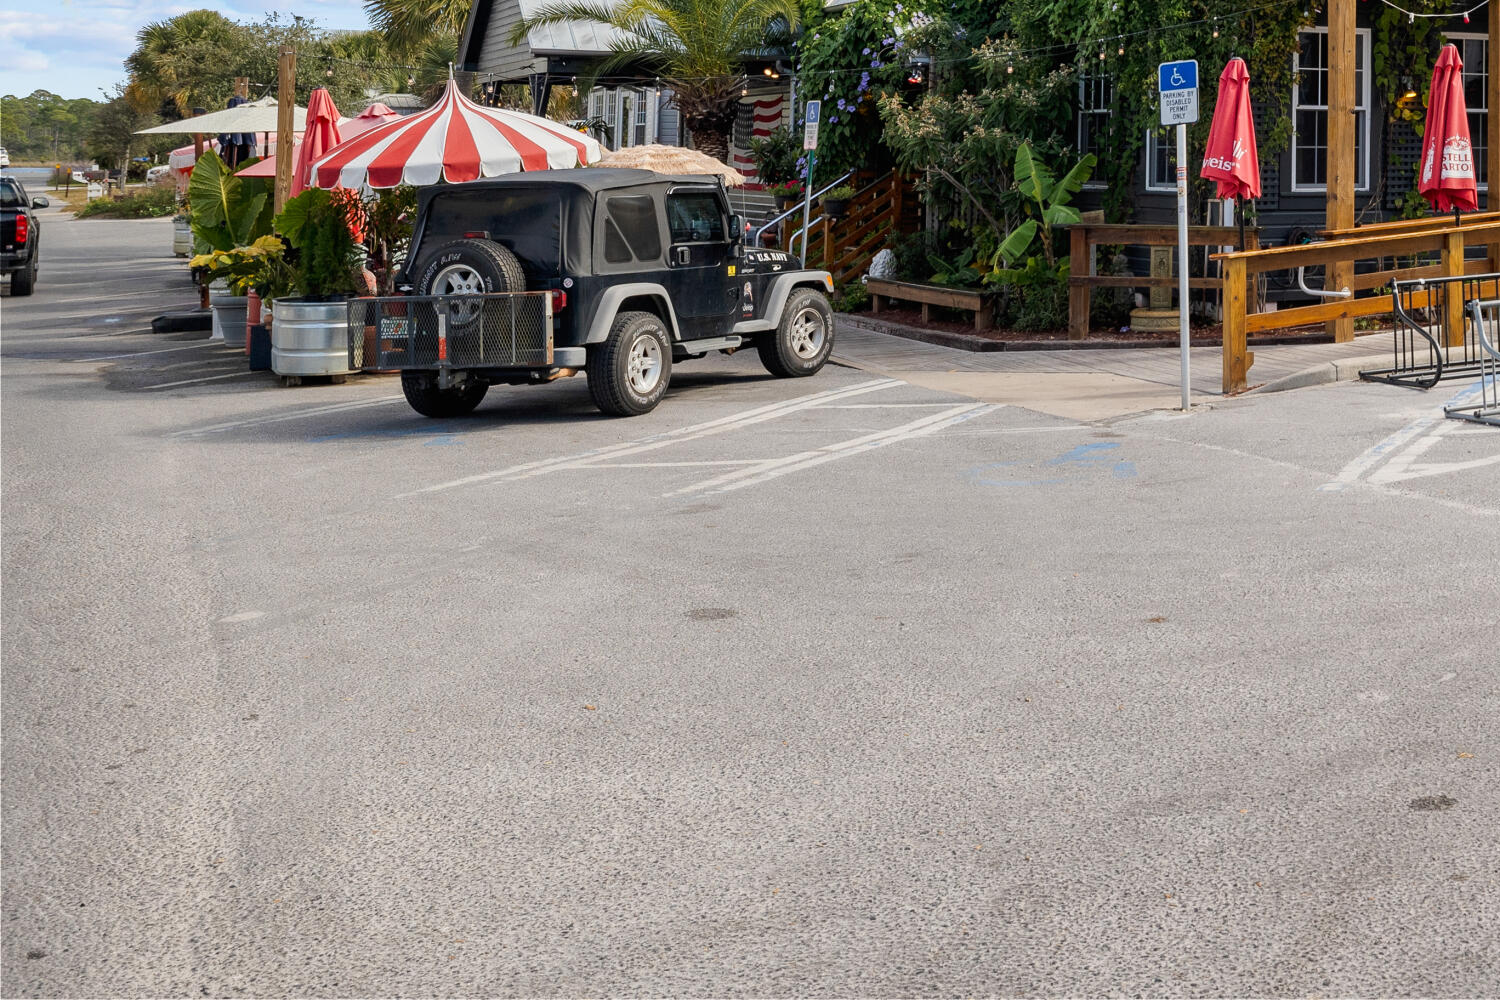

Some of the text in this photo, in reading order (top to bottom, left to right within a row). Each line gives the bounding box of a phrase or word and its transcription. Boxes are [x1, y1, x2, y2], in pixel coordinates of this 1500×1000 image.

[1162, 91, 1185, 99] PARKING
[1166, 98, 1192, 106] DISABLED
[771, 252, 788, 262] NAVY
[742, 303, 754, 312] Jeep
